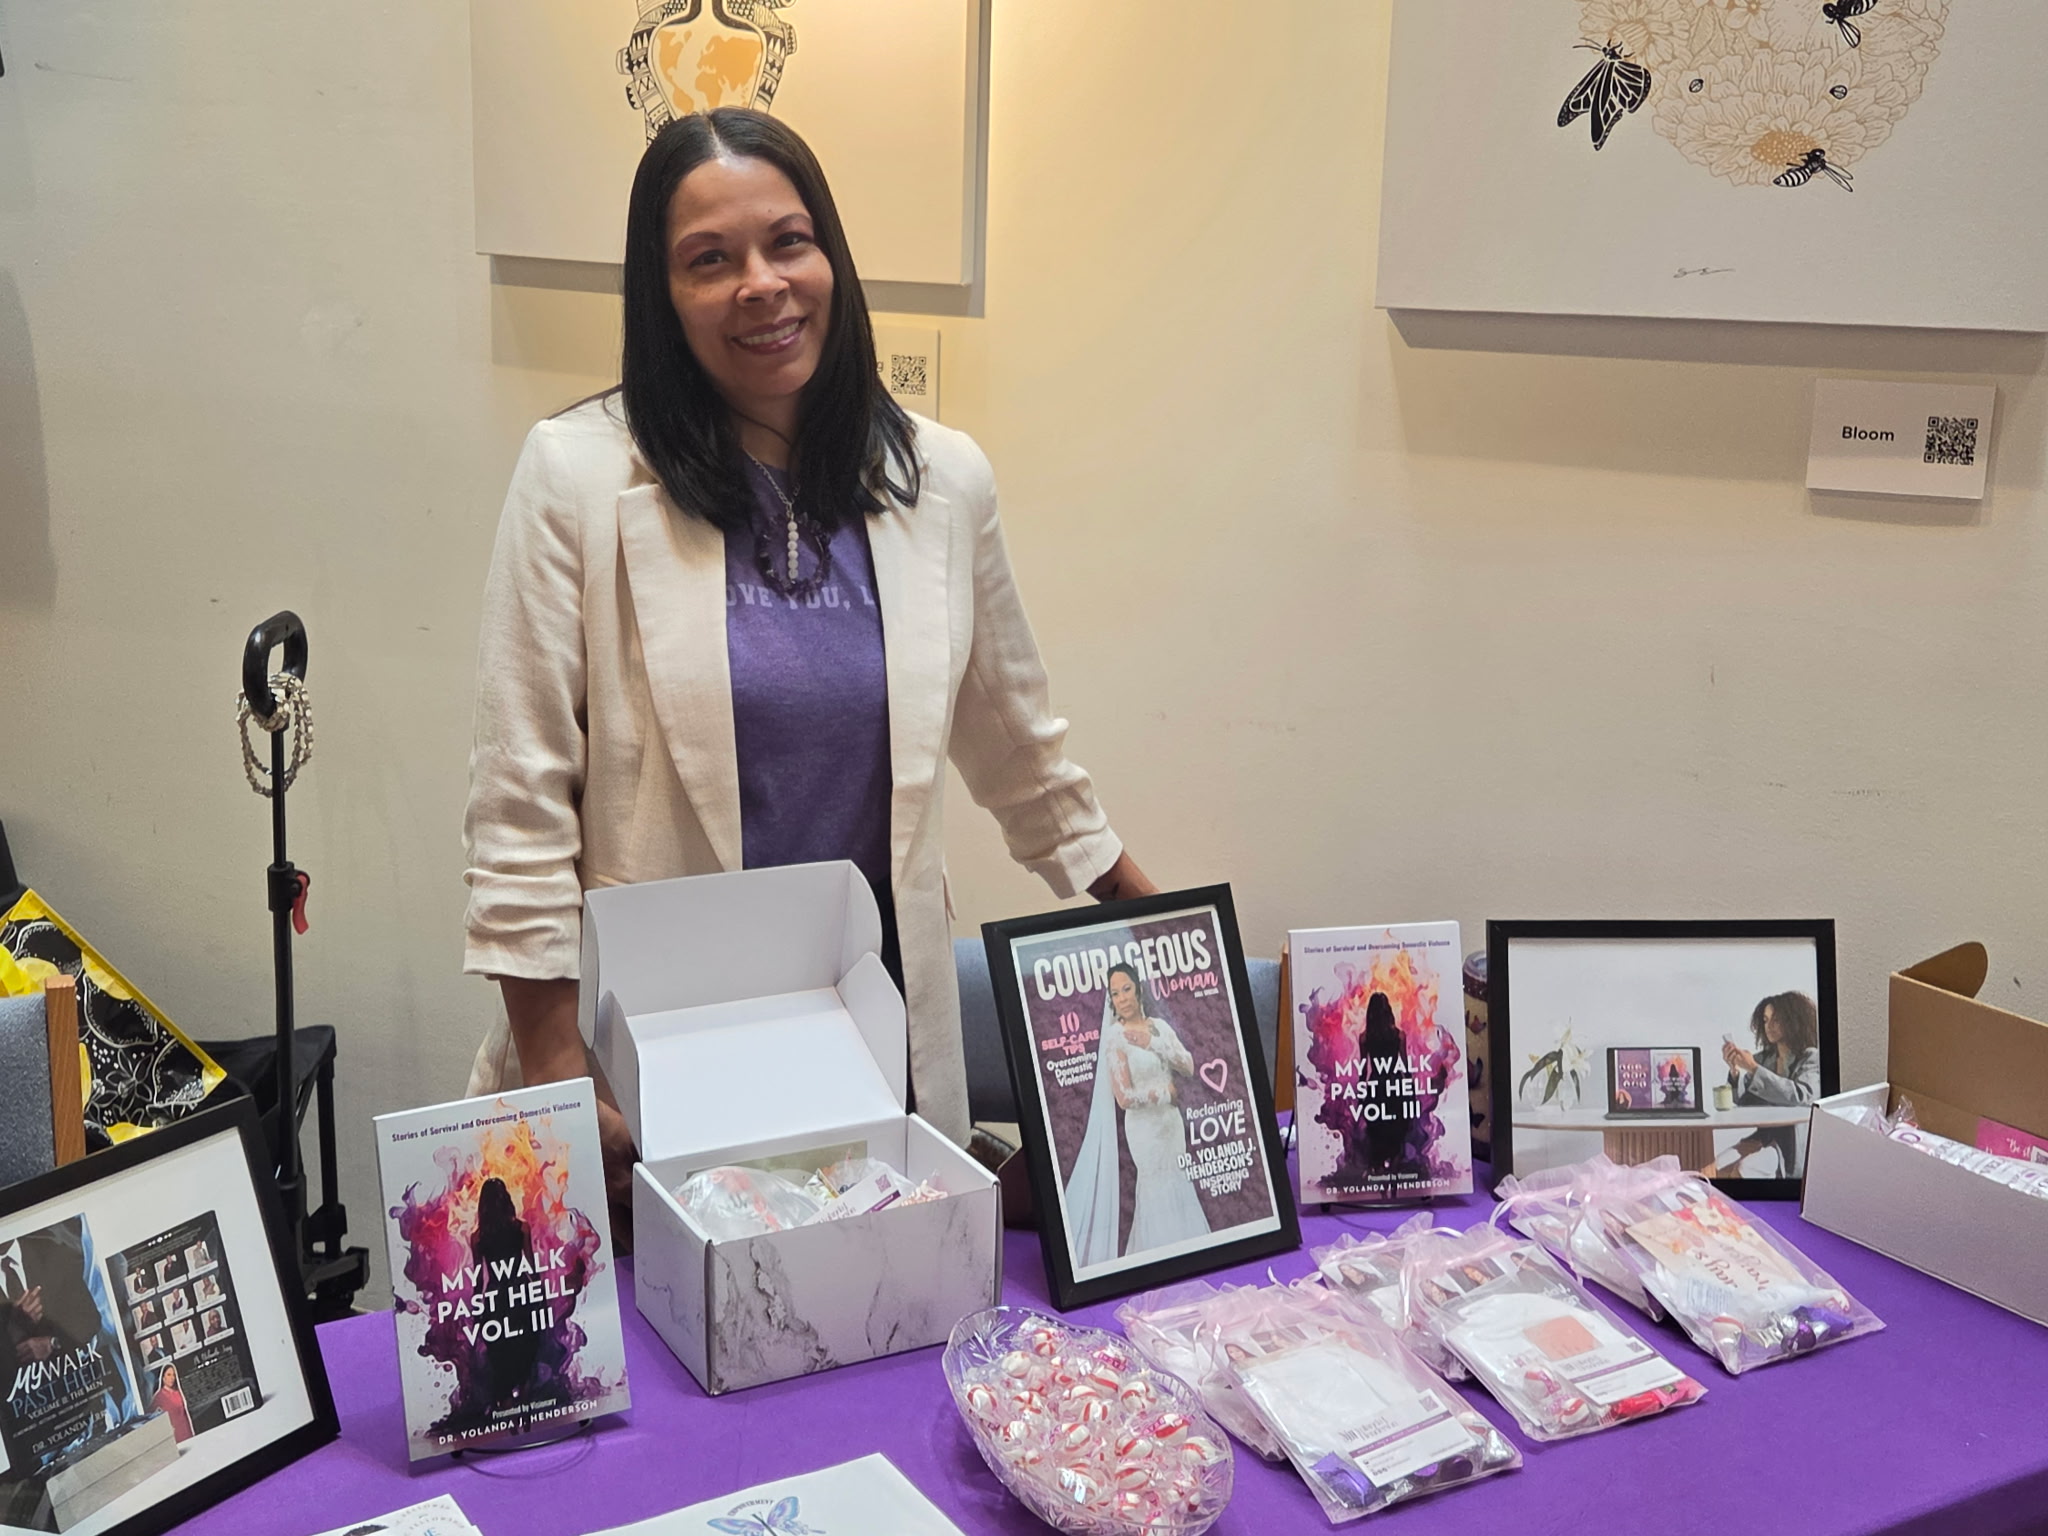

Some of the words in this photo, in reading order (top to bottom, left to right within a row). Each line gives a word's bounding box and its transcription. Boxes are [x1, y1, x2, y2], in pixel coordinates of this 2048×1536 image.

[1841, 426, 1895, 442] Bloom
[1304, 946, 1324, 954] Stories
[1368, 943, 1400, 951] Overcoming
[1034, 929, 1211, 1001] COURAGEOUS
[1150, 971, 1219, 1001] Woman
[1059, 1011, 1080, 1034] 10
[1041, 1029, 1099, 1051] SELF-CARE
[1062, 1043, 1085, 1056] TIPS
[1046, 1052, 1097, 1071] Overcoming
[1055, 1061, 1092, 1079] Domestic
[1335, 1058, 1367, 1077] MY
[1373, 1054, 1432, 1074] WALK
[1057, 1072, 1093, 1087] Violence
[1331, 1080, 1378, 1101] PAST
[1386, 1076, 1438, 1097] HELL
[392, 1131, 419, 1142] Stories
[420, 1128, 428, 1137] of
[430, 1122, 459, 1136] Survival
[461, 1120, 474, 1130] and
[475, 1113, 518, 1127] Overcoming
[519, 1106, 551, 1119] Domestic
[552, 1101, 581, 1112] Violence
[1186, 1099, 1243, 1120] Reclaiming
[1349, 1103, 1397, 1122] VOL.
[1402, 1101, 1421, 1120] III
[1189, 1110, 1246, 1145] LOVE
[1177, 1153, 1196, 1169] DR.
[1196, 1140, 1245, 1163] YOLANDA
[1247, 1137, 1256, 1152] J.
[1185, 1151, 1253, 1181] HENDERSON'S
[1199, 1168, 1249, 1189] INSPIRING
[1210, 1180, 1242, 1197] STORY
[1343, 1184, 1385, 1193] YOLANDA
[1397, 1180, 1450, 1190] HENDERSON
[442, 1264, 482, 1294] MY
[490, 1246, 566, 1282] WALK
[437, 1290, 498, 1324] PAST
[508, 1275, 574, 1308] HELL
[462, 1316, 523, 1346] VOL.
[531, 1307, 554, 1332] III
[6, 1360, 44, 1402] MY
[41, 1335, 102, 1381] WALK
[12, 1380, 57, 1418] PAST
[63, 1359, 112, 1393] HELL
[28, 1401, 60, 1420] VOLUME
[70, 1388, 85, 1401] THE
[85, 1381, 103, 1393] MEN
[492, 1404, 521, 1419] Presented
[522, 1403, 529, 1412] by
[530, 1398, 557, 1410] Visionary
[438, 1434, 456, 1445] DR.
[461, 1421, 514, 1440] YOLANDA
[519, 1416, 526, 1428] J.
[530, 1400, 597, 1424] HENDERSON
[32, 1442, 48, 1454] DR.
[48, 1420, 88, 1444] YOLANDA
